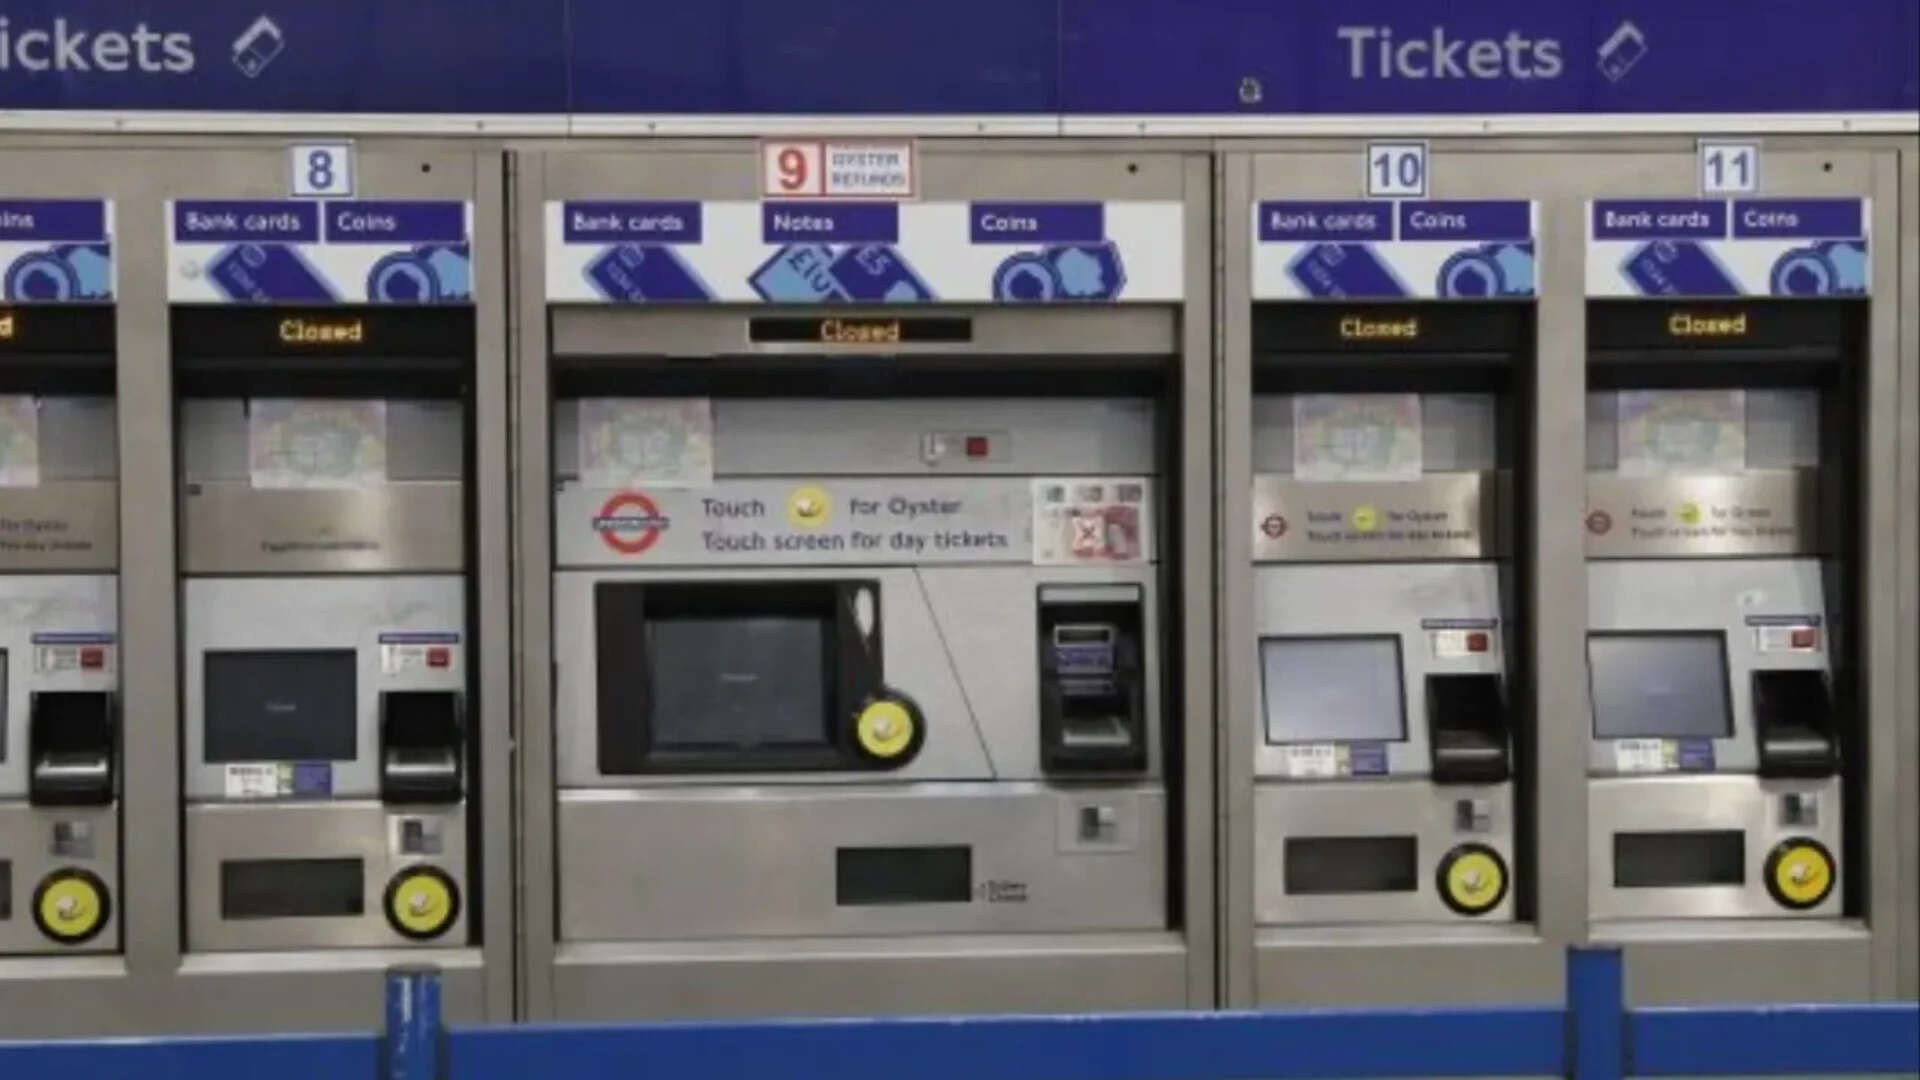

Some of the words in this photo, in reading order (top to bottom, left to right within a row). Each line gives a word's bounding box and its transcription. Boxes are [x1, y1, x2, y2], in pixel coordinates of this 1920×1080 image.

[1337, 25, 1563, 79] Tickets
[308, 150, 334, 190] 8
[778, 148, 807, 190] 9
[1373, 152, 1421, 188] 10
[1706, 151, 1750, 186] 11
[0, 211, 35, 229] ins
[186, 211, 237, 231] Bank
[243, 212, 301, 231] cards
[337, 211, 397, 231] Coins
[573, 212, 623, 231] Bank
[629, 213, 684, 231] cards
[773, 213, 835, 231] Notes
[980, 213, 1038, 231] Coins
[1271, 211, 1318, 229] Bank
[1323, 212, 1377, 230] cards
[1409, 210, 1467, 229] Coins
[1605, 210, 1652, 228] Bank
[1658, 211, 1710, 228] cards
[1743, 209, 1799, 228] Coins
[280, 319, 363, 342] Closed
[820, 319, 900, 342] Closed
[1340, 318, 1417, 338] Closed
[1669, 314, 1747, 335] Closed
[702, 497, 766, 519] Touch
[849, 497, 881, 516] for
[887, 496, 962, 521] Oyster
[702, 530, 765, 552] Touch
[774, 533, 845, 552] screen
[851, 530, 882, 549] for
[889, 530, 927, 554] day
[933, 529, 1008, 549] tickets
